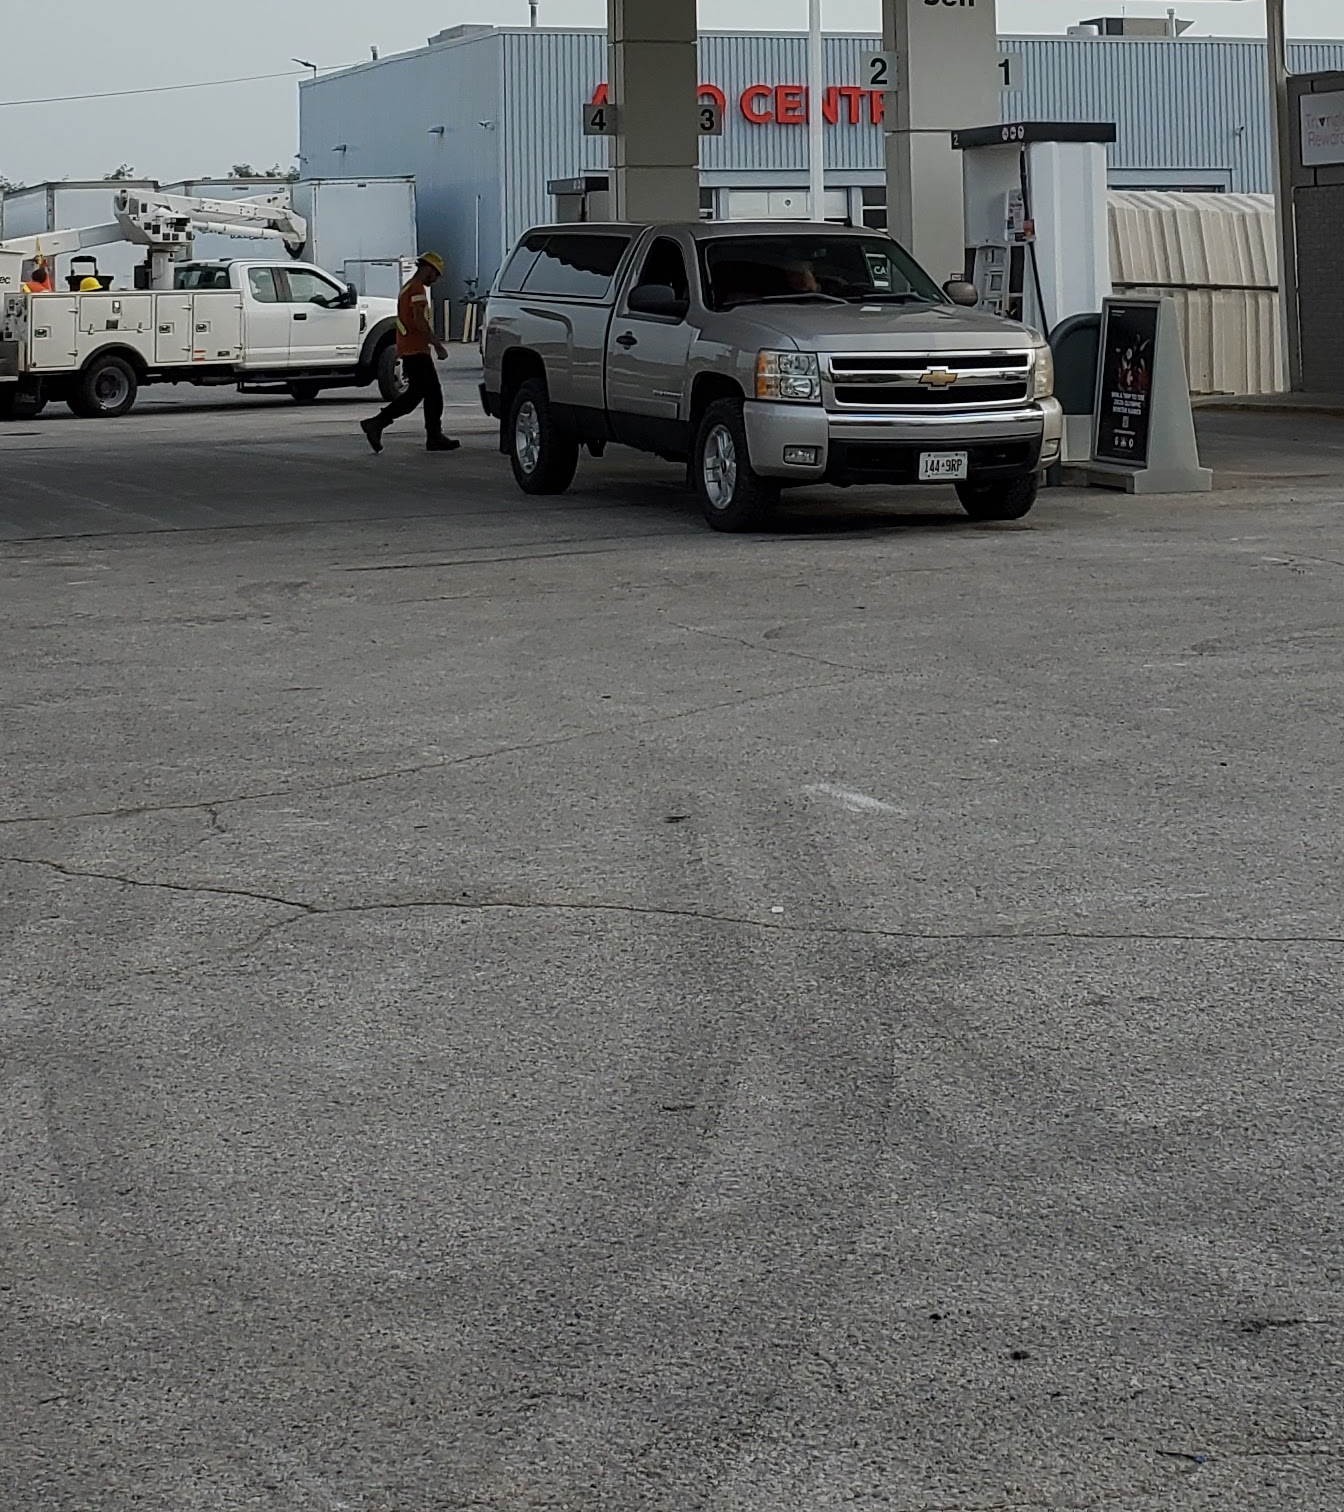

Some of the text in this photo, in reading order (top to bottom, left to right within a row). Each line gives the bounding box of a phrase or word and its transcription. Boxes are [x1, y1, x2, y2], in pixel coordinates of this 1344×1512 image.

[870, 57, 888, 85] 2
[998, 58, 1010, 86] 1
[740, 84, 885, 125] CENT
[591, 109, 607, 131] 4
[700, 108, 715, 131] 3
